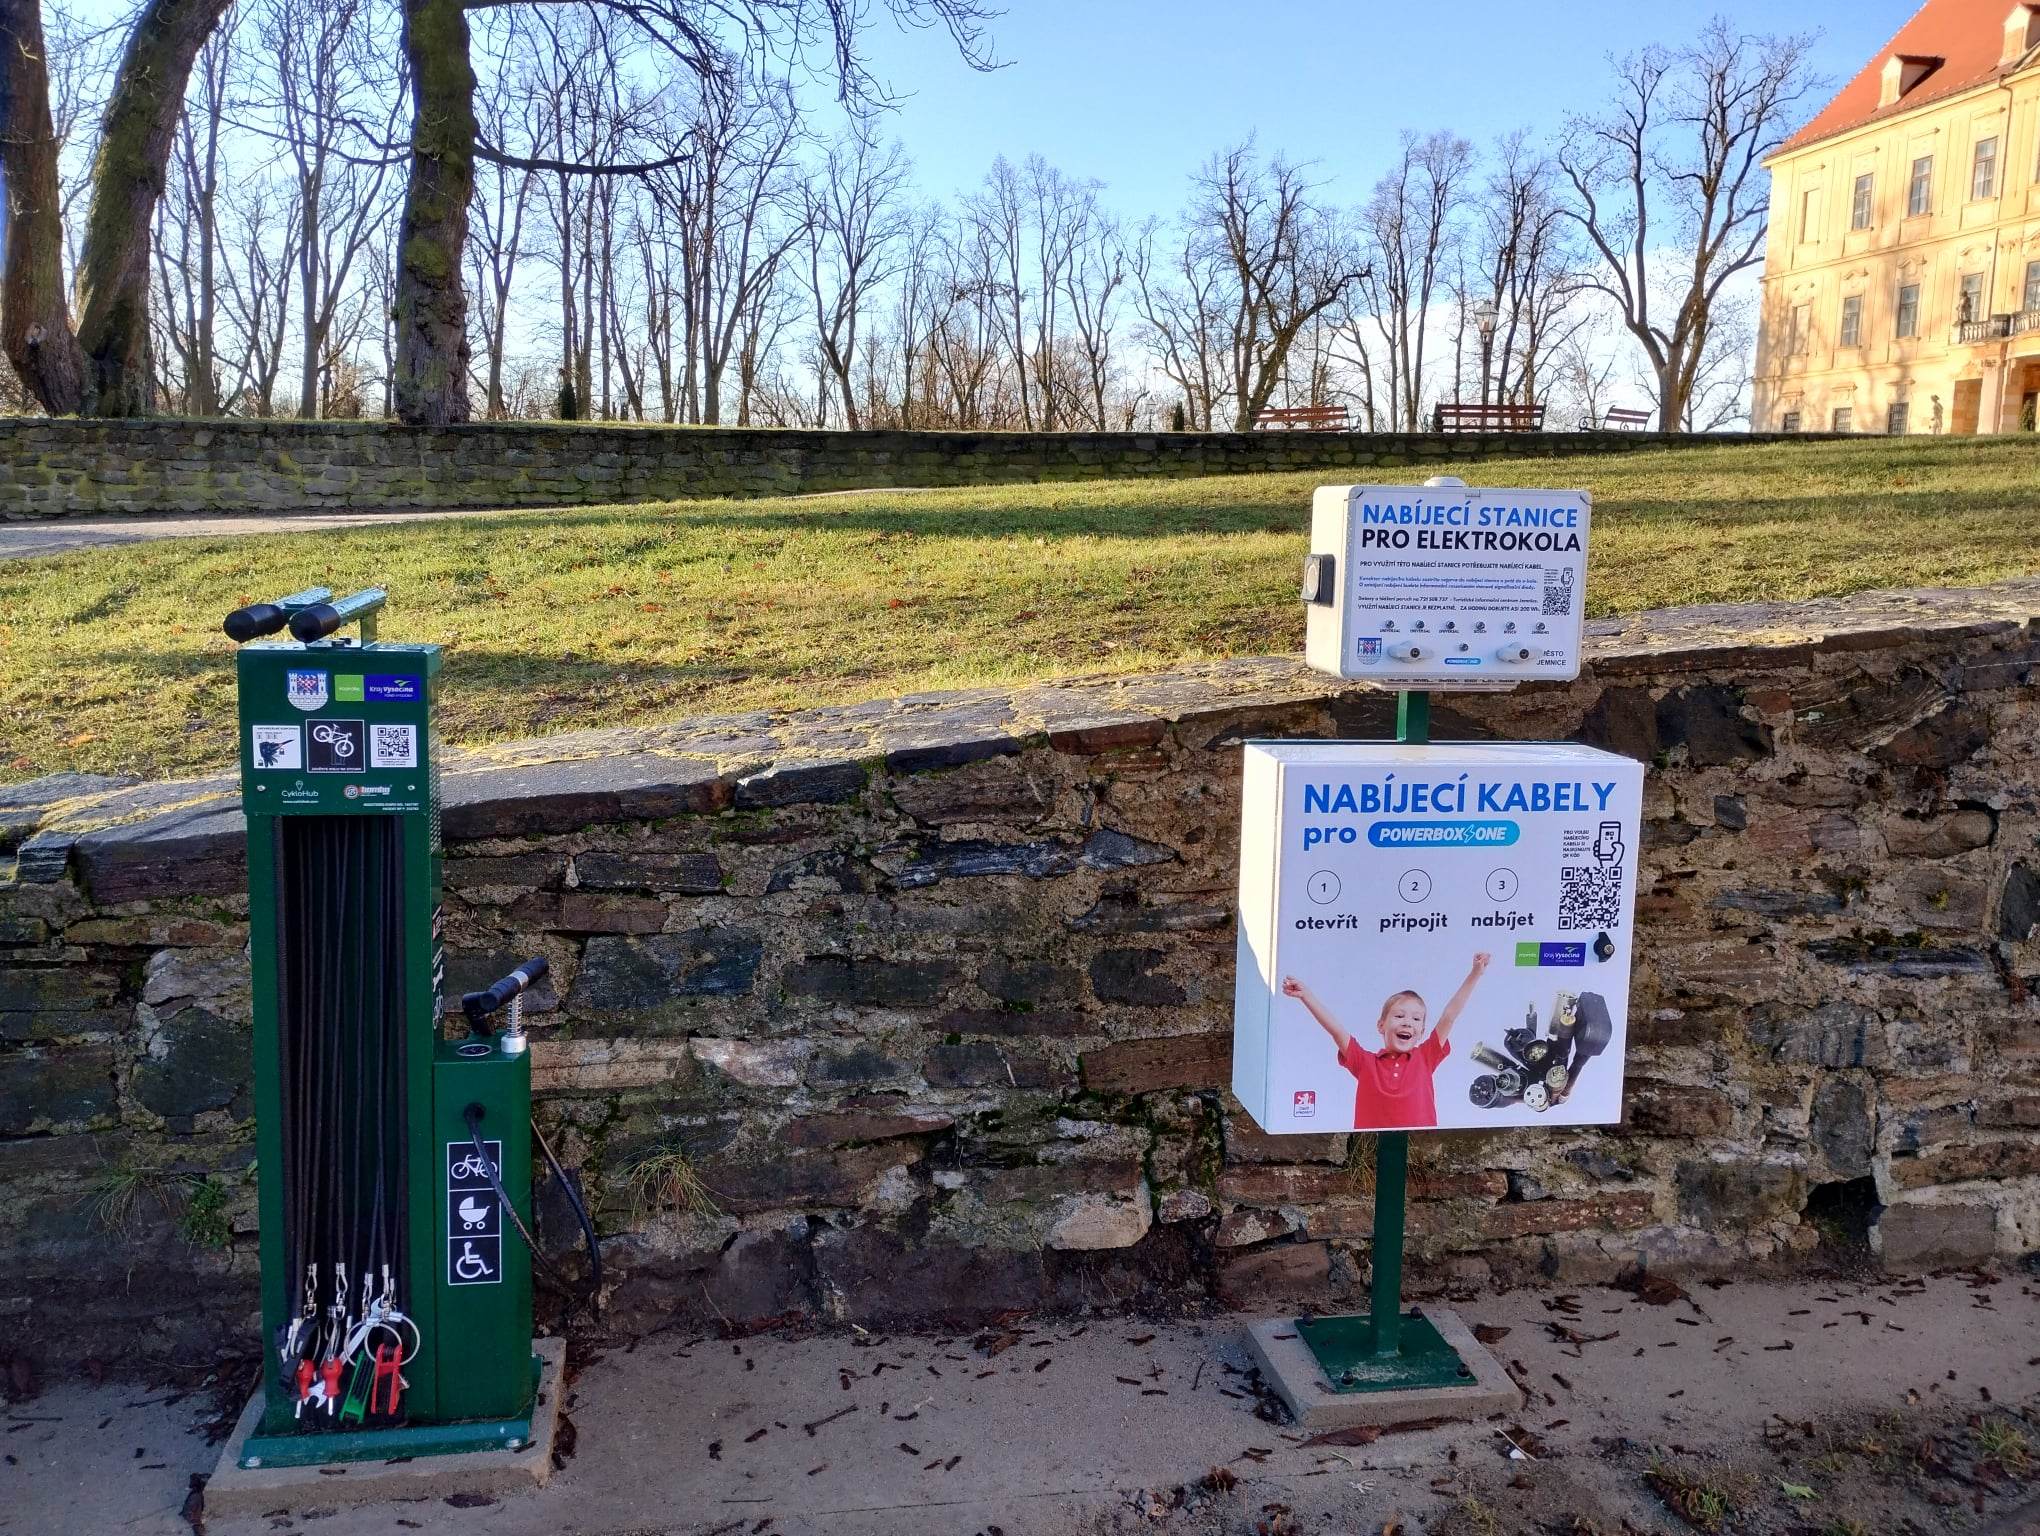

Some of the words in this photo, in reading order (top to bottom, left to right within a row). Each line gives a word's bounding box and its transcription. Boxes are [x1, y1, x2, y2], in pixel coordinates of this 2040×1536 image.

[1363, 499, 1471, 525] NABÍJECÍ
[1478, 507, 1578, 528] STANICE
[1362, 529, 1410, 549] PRO
[1417, 530, 1581, 552] ELEKTROKOLA
[1412, 560, 1436, 568] NABÍJECÍ
[1500, 561, 1524, 569] NABÍJECÍ
[1304, 773, 1469, 813] NABÍJECÍ
[1478, 782, 1617, 812] KABELY
[1304, 826, 1357, 851] pro
[1379, 827, 1464, 842] POWERBOX
[1476, 826, 1507, 842] ONE
[1320, 882, 1326, 892] 1
[1412, 882, 1418, 891] 2
[1498, 880, 1506, 890] 3
[1295, 914, 1358, 930] otevřít
[1380, 912, 1448, 932] připojit
[1471, 911, 1534, 930] nabíjet
